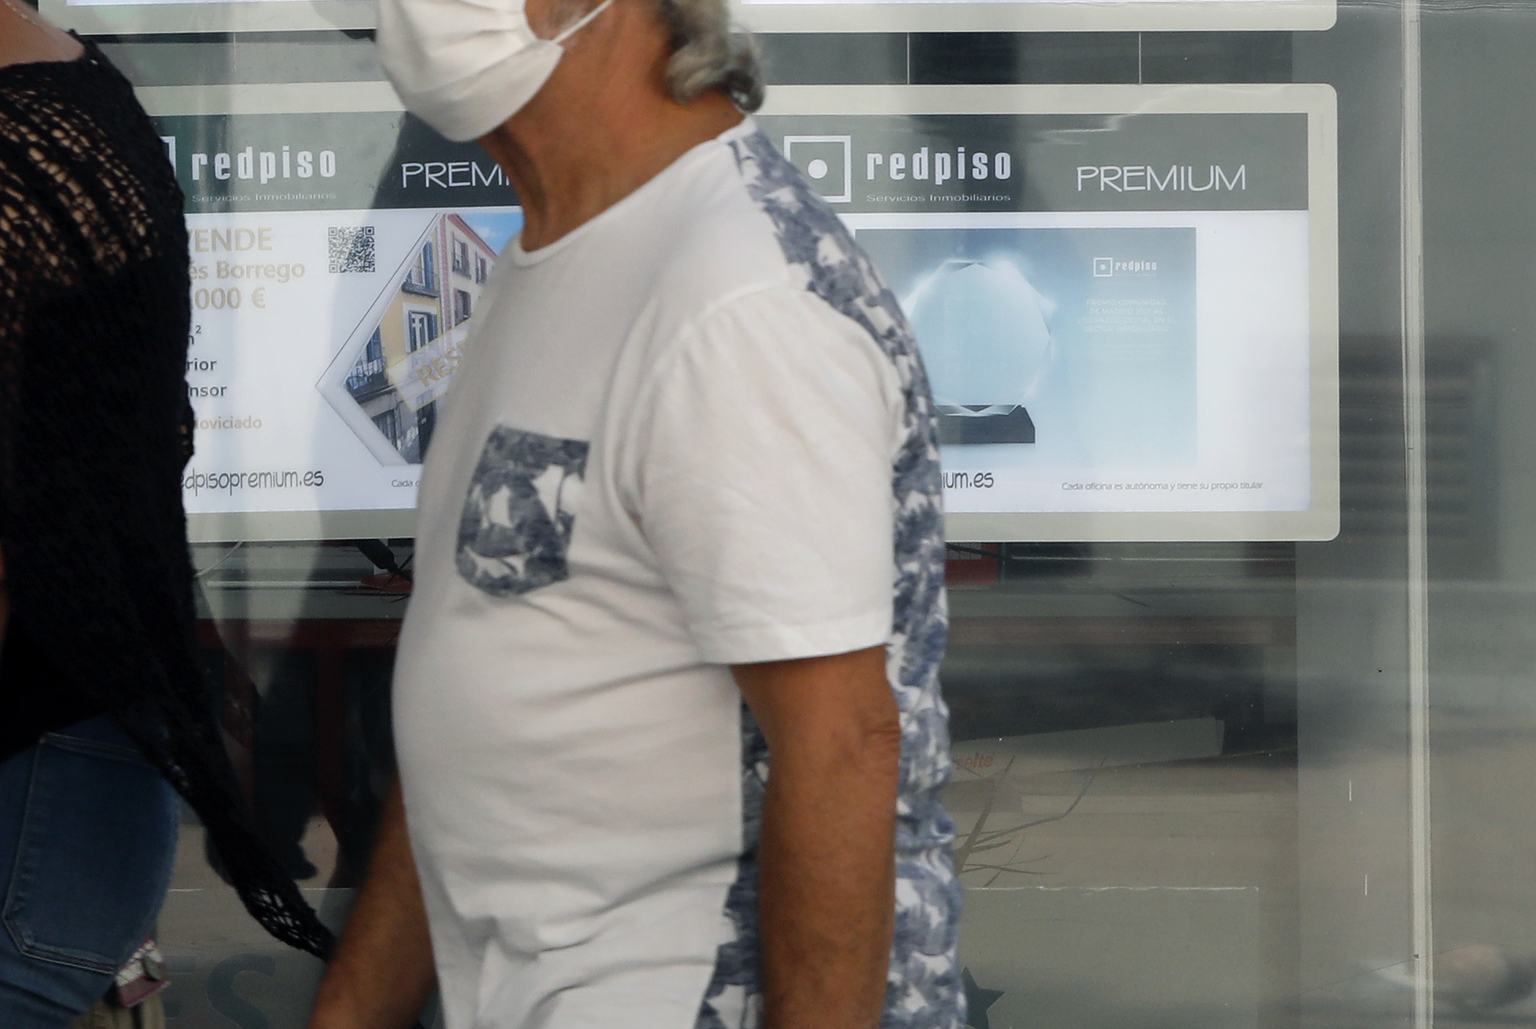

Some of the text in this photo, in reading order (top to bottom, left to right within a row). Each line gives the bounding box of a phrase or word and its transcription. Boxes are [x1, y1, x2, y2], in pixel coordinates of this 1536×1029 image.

[192, 146, 336, 184] redpiso
[867, 146, 1011, 185] redpiso
[1078, 165, 1245, 191] PREMIUM
[867, 193, 1011, 202] Servicios Inmobiliarios
[216, 260, 305, 283] Borrego
